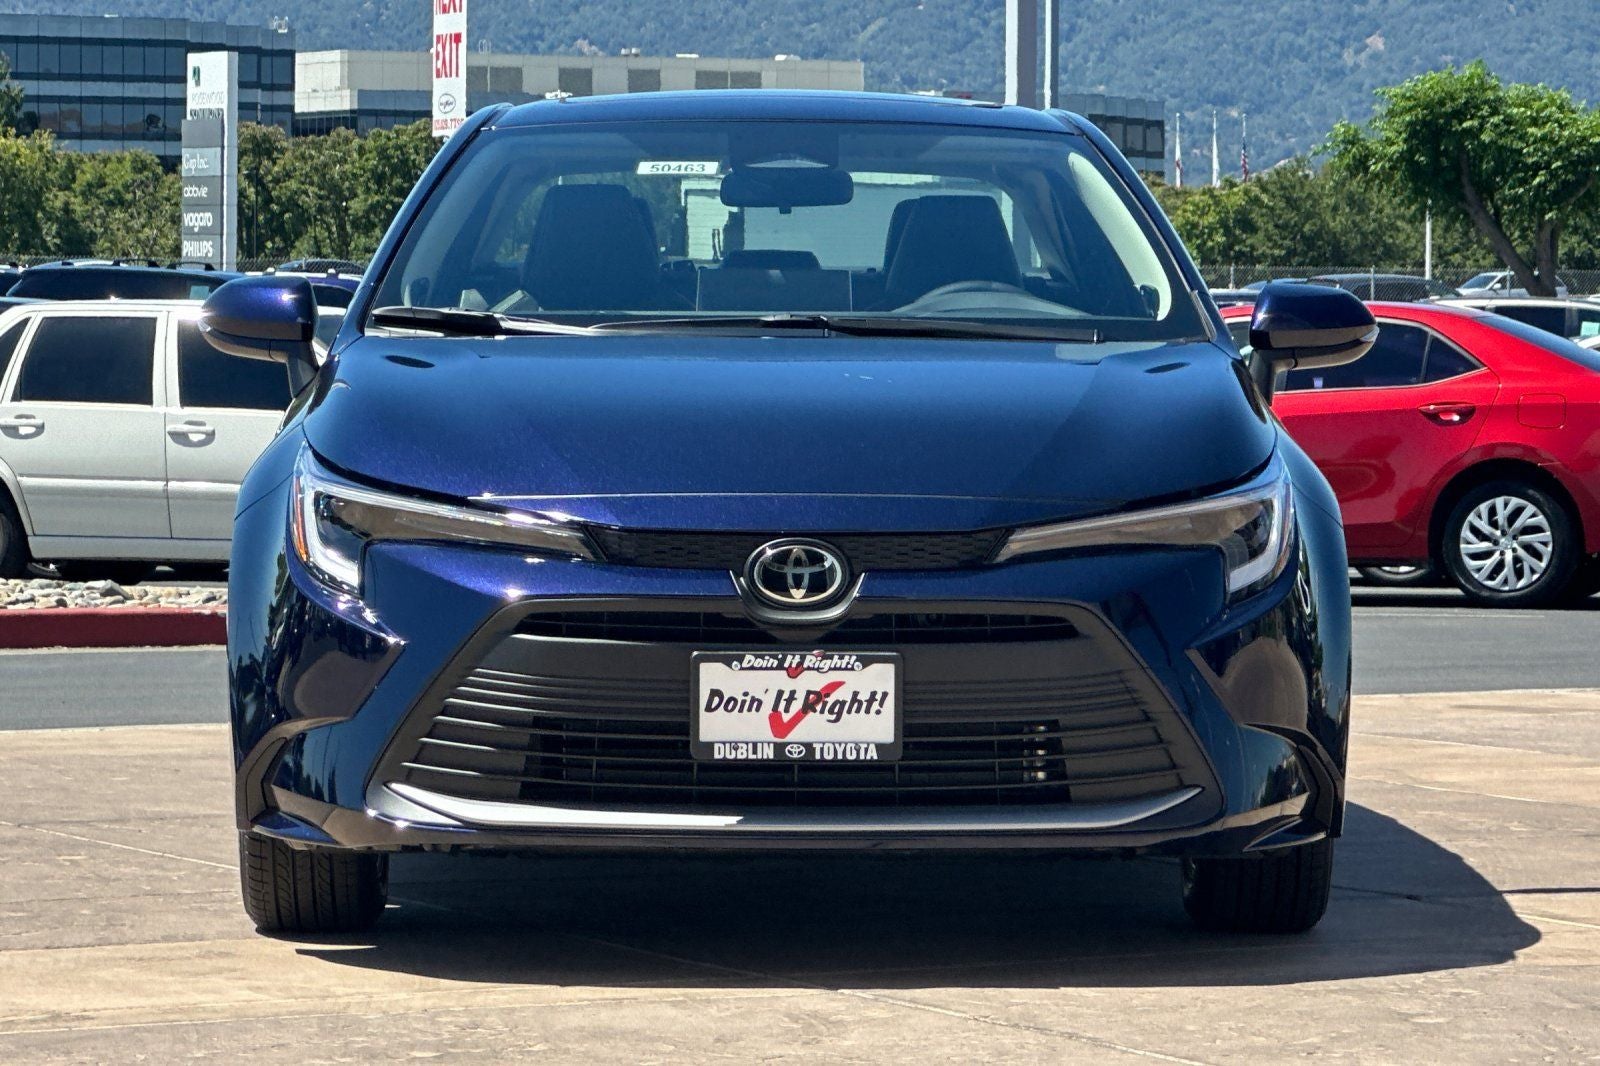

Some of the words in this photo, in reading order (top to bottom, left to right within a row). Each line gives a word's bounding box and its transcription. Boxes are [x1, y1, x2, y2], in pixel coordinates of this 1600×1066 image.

[435, 32, 462, 79] EXIT
[183, 153, 196, 175] Gap
[649, 163, 706, 173] 50463
[183, 184, 208, 198] abbvie
[183, 211, 213, 232] vagaro
[182, 240, 213, 258] PHILIPS
[741, 654, 783, 668] Doin'
[783, 654, 802, 668] It
[803, 655, 857, 673] Right!
[704, 688, 769, 713] Doin'
[771, 689, 797, 714] It
[801, 690, 889, 723] Right!
[713, 742, 774, 759] DUBLIN
[812, 743, 878, 760] TOYOTA
